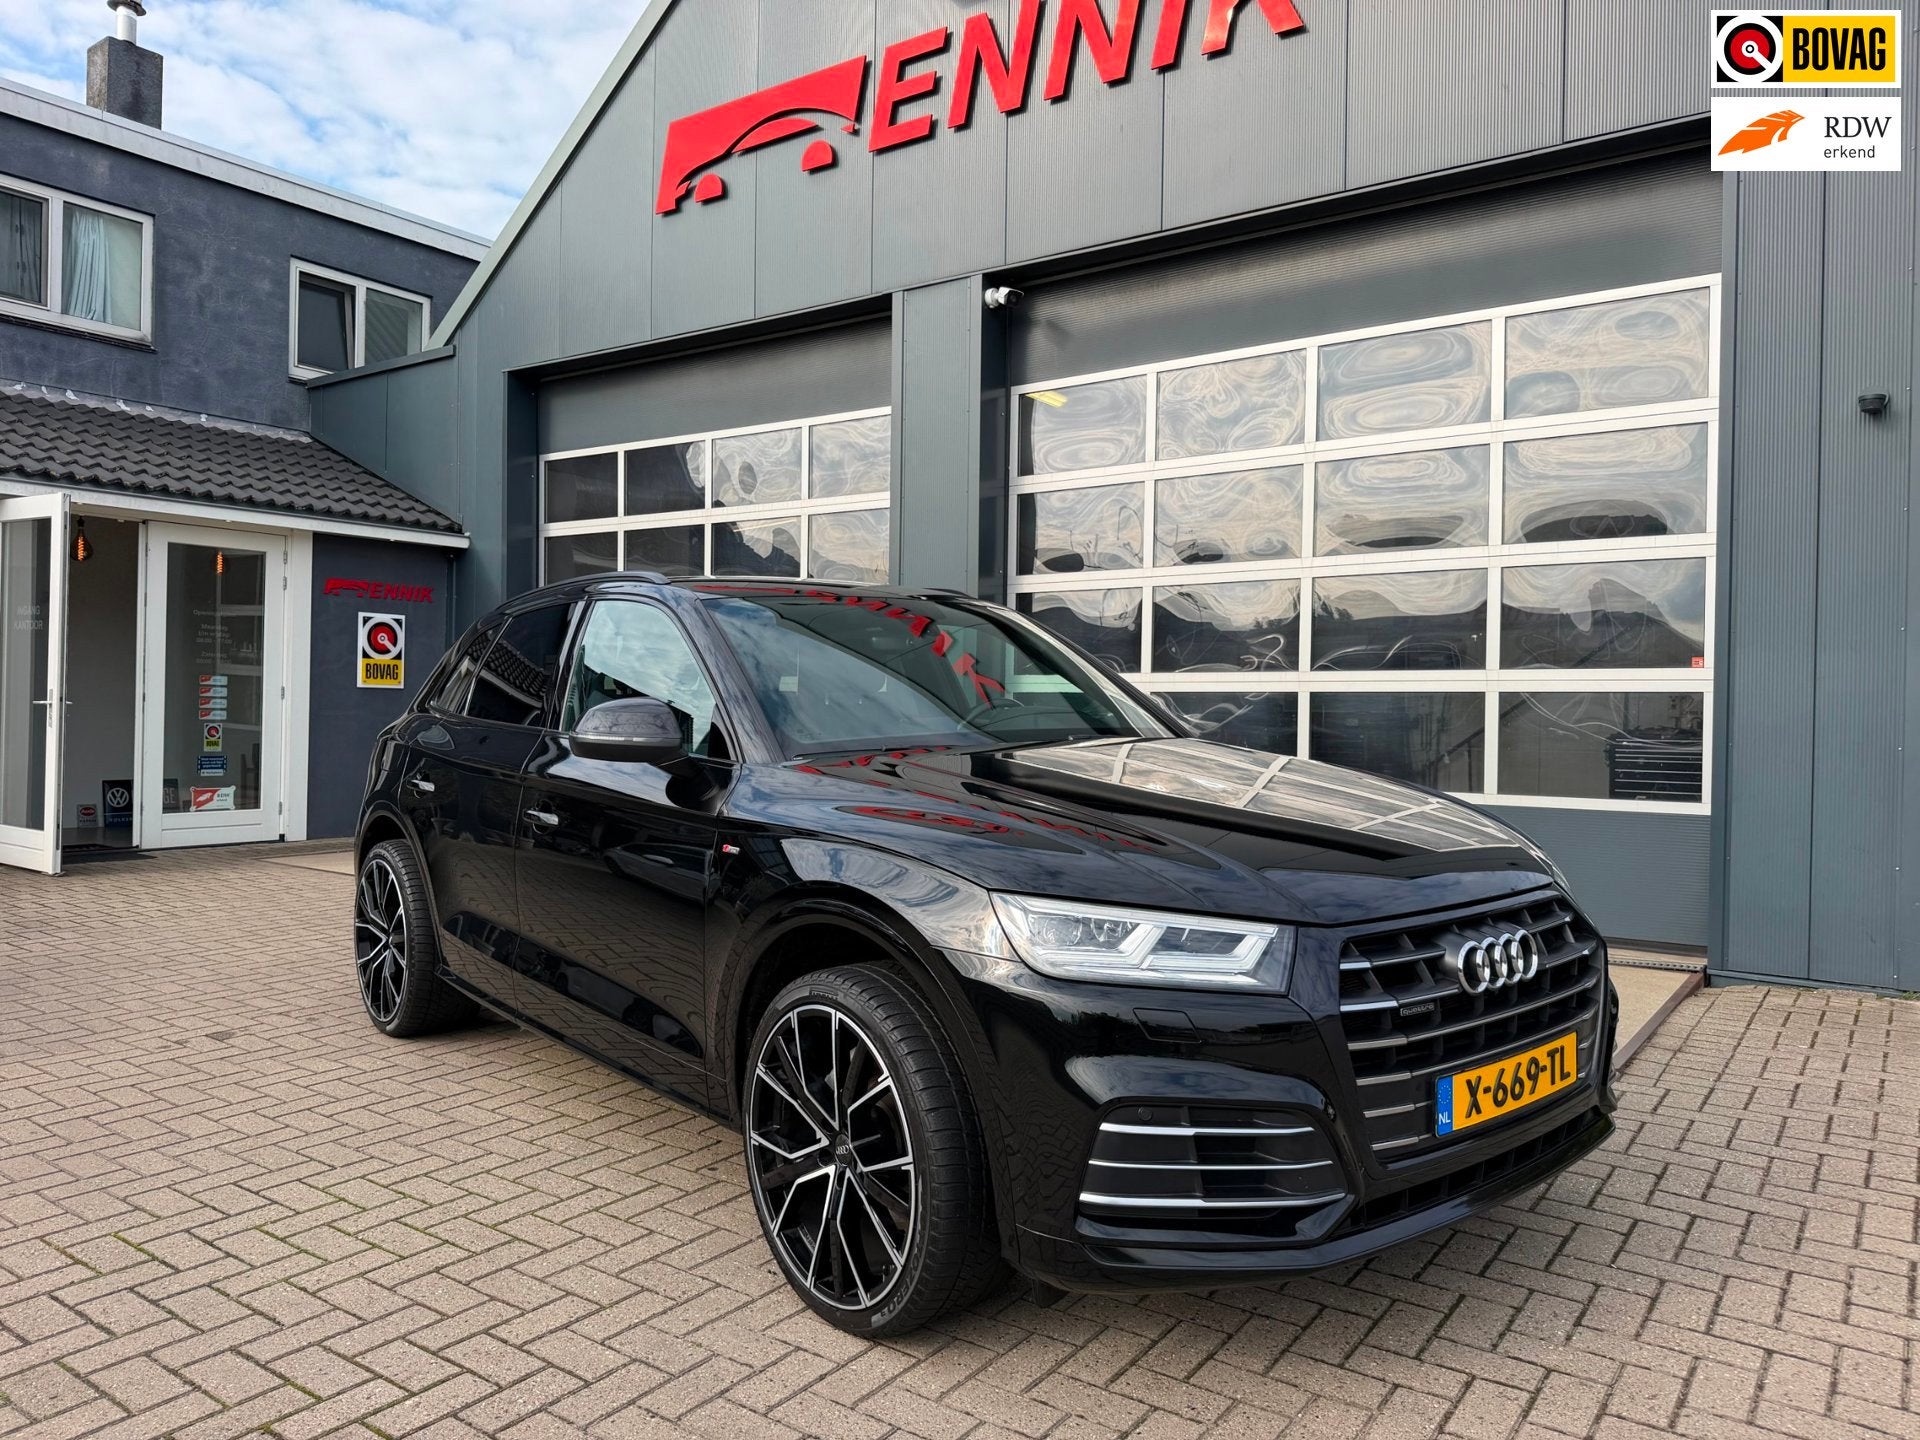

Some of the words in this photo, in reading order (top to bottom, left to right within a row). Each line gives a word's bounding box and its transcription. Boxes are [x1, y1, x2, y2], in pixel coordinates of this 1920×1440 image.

[365, 663, 399, 680] BOVAG
[1465, 1045, 1571, 1119] X-669-TL
[1438, 1111, 1451, 1126] NL
